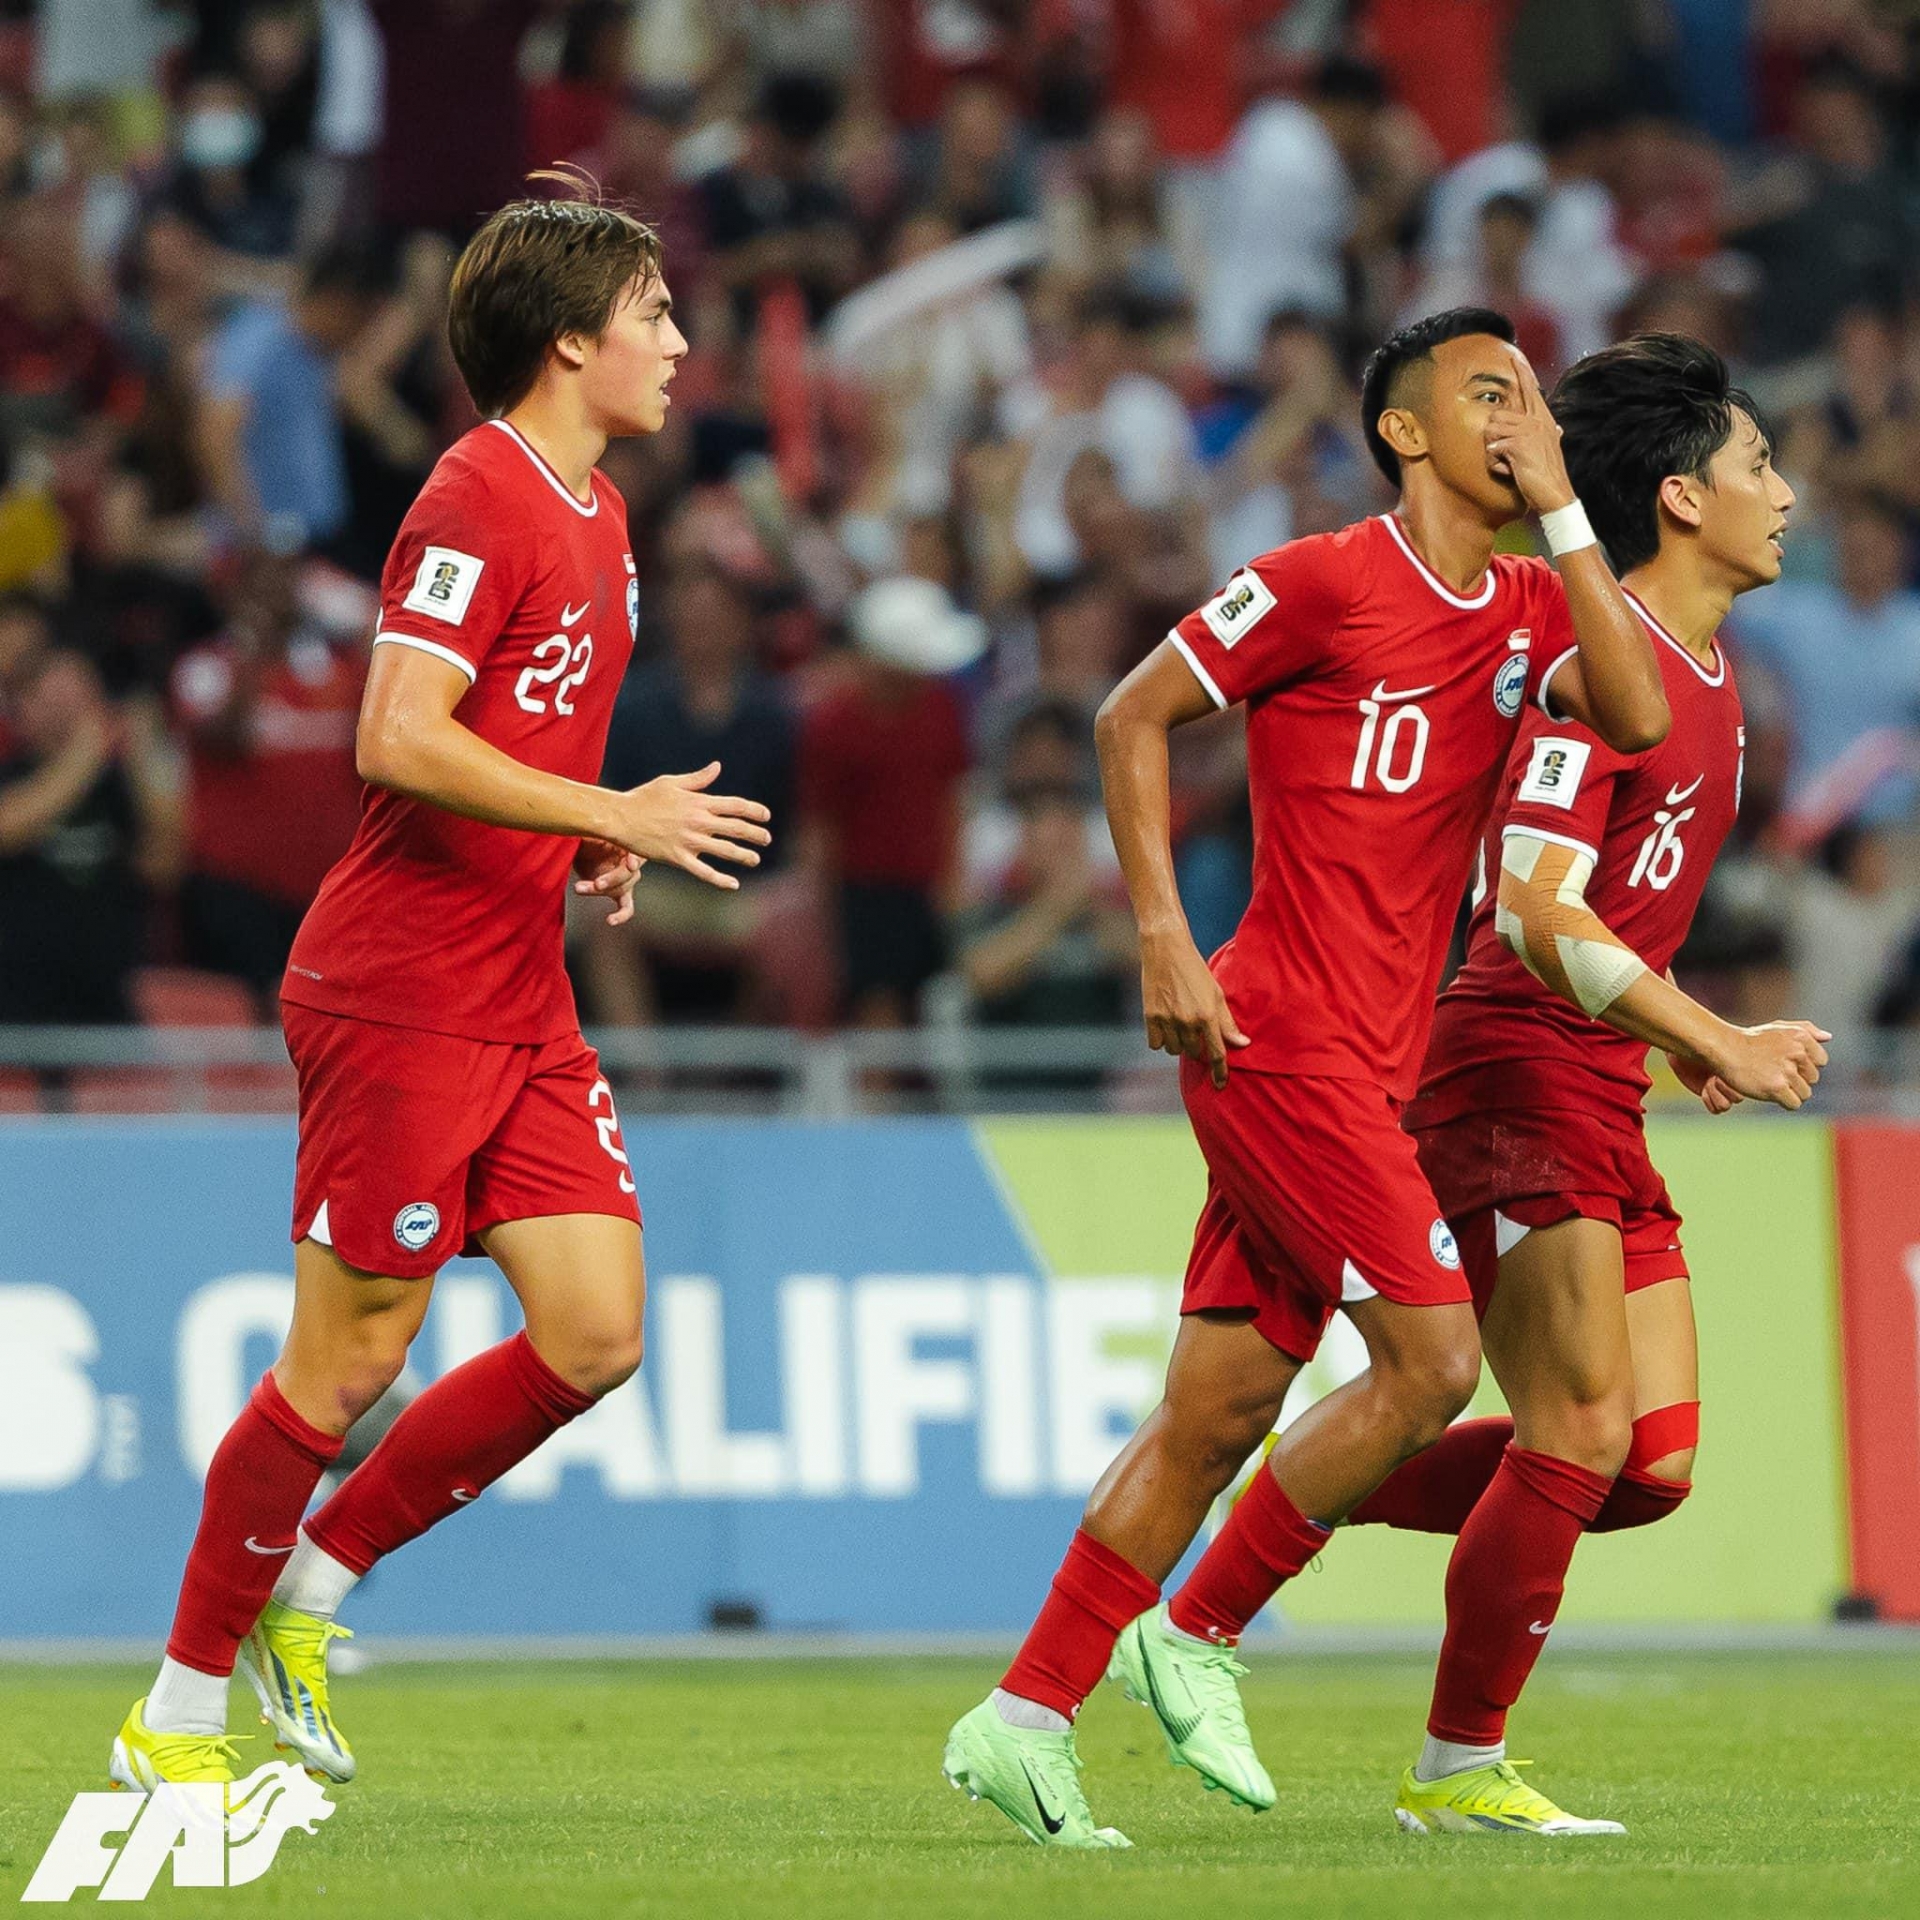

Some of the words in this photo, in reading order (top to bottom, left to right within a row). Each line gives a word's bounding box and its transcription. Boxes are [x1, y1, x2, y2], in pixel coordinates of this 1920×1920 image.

[514, 633, 593, 716] 22
[1350, 698, 1430, 794] 10
[1627, 807, 1696, 890] 16
